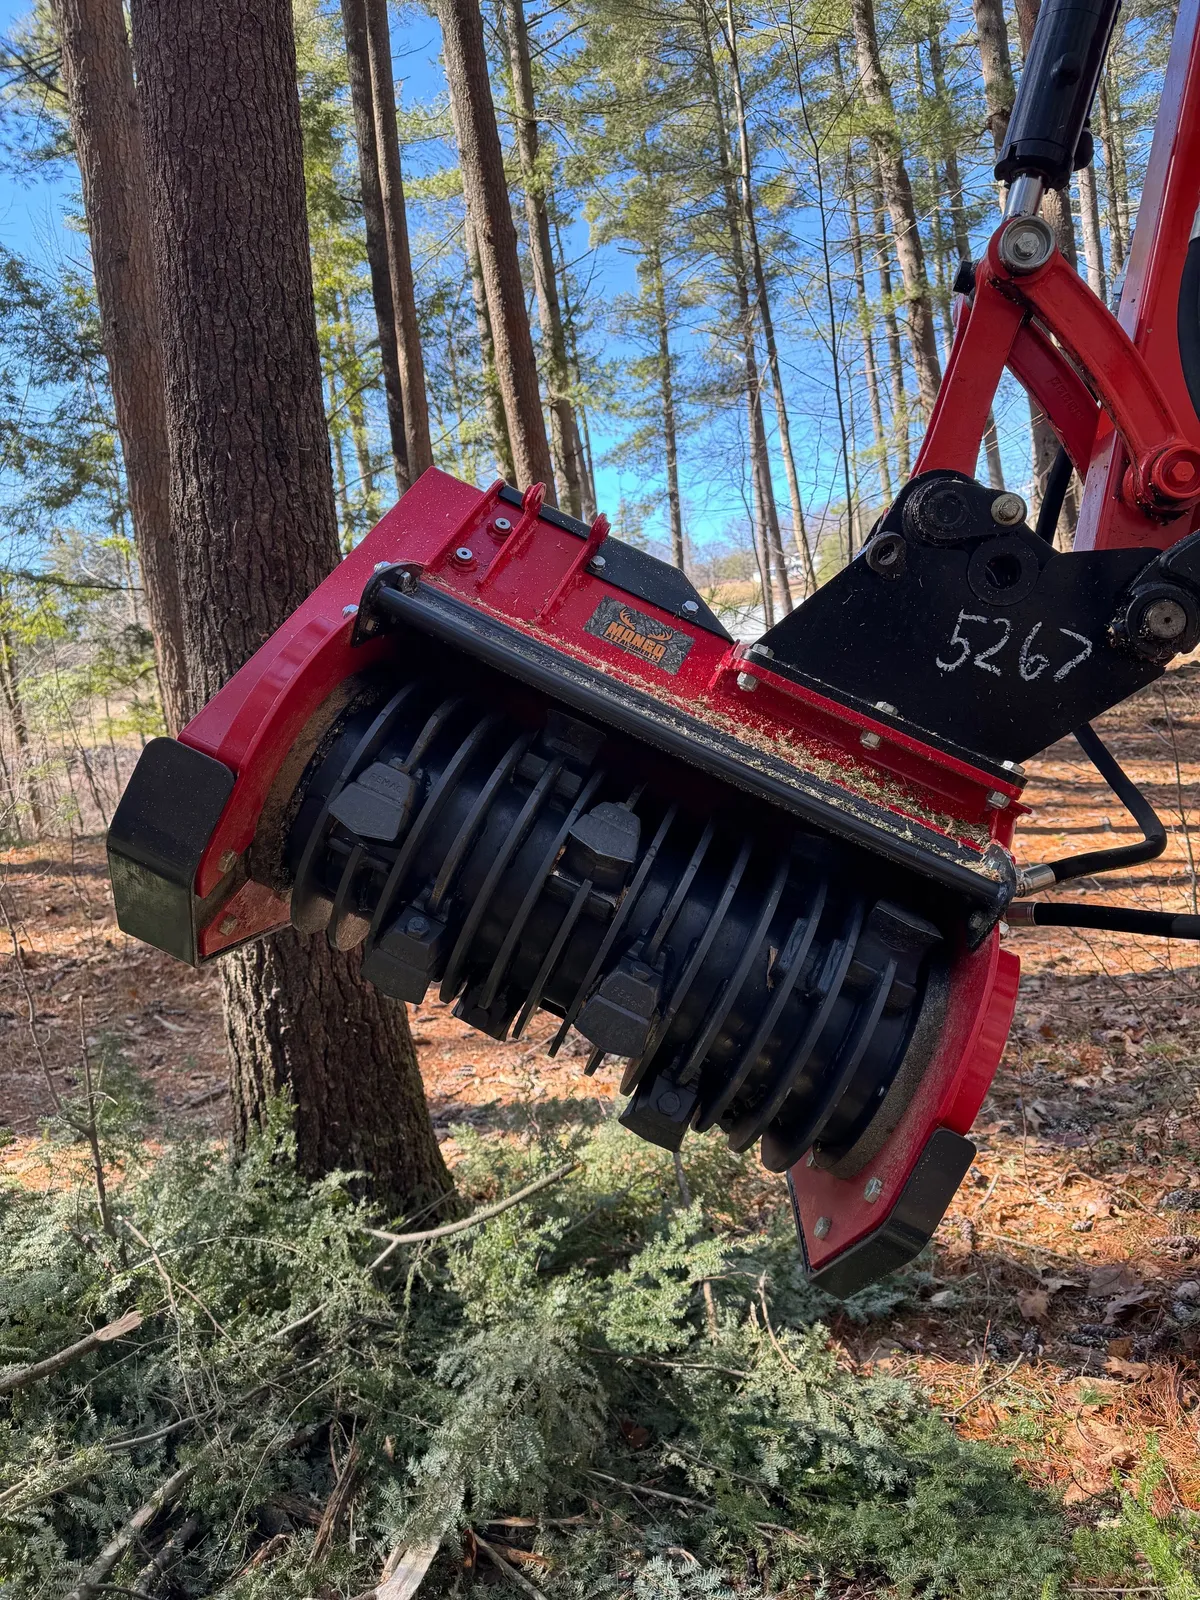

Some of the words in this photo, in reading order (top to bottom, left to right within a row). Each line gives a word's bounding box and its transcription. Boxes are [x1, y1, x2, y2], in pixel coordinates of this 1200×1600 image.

[607, 622, 667, 656] MONGO
[935, 608, 1093, 682] 5267
[369, 772, 405, 793] FEMAC
